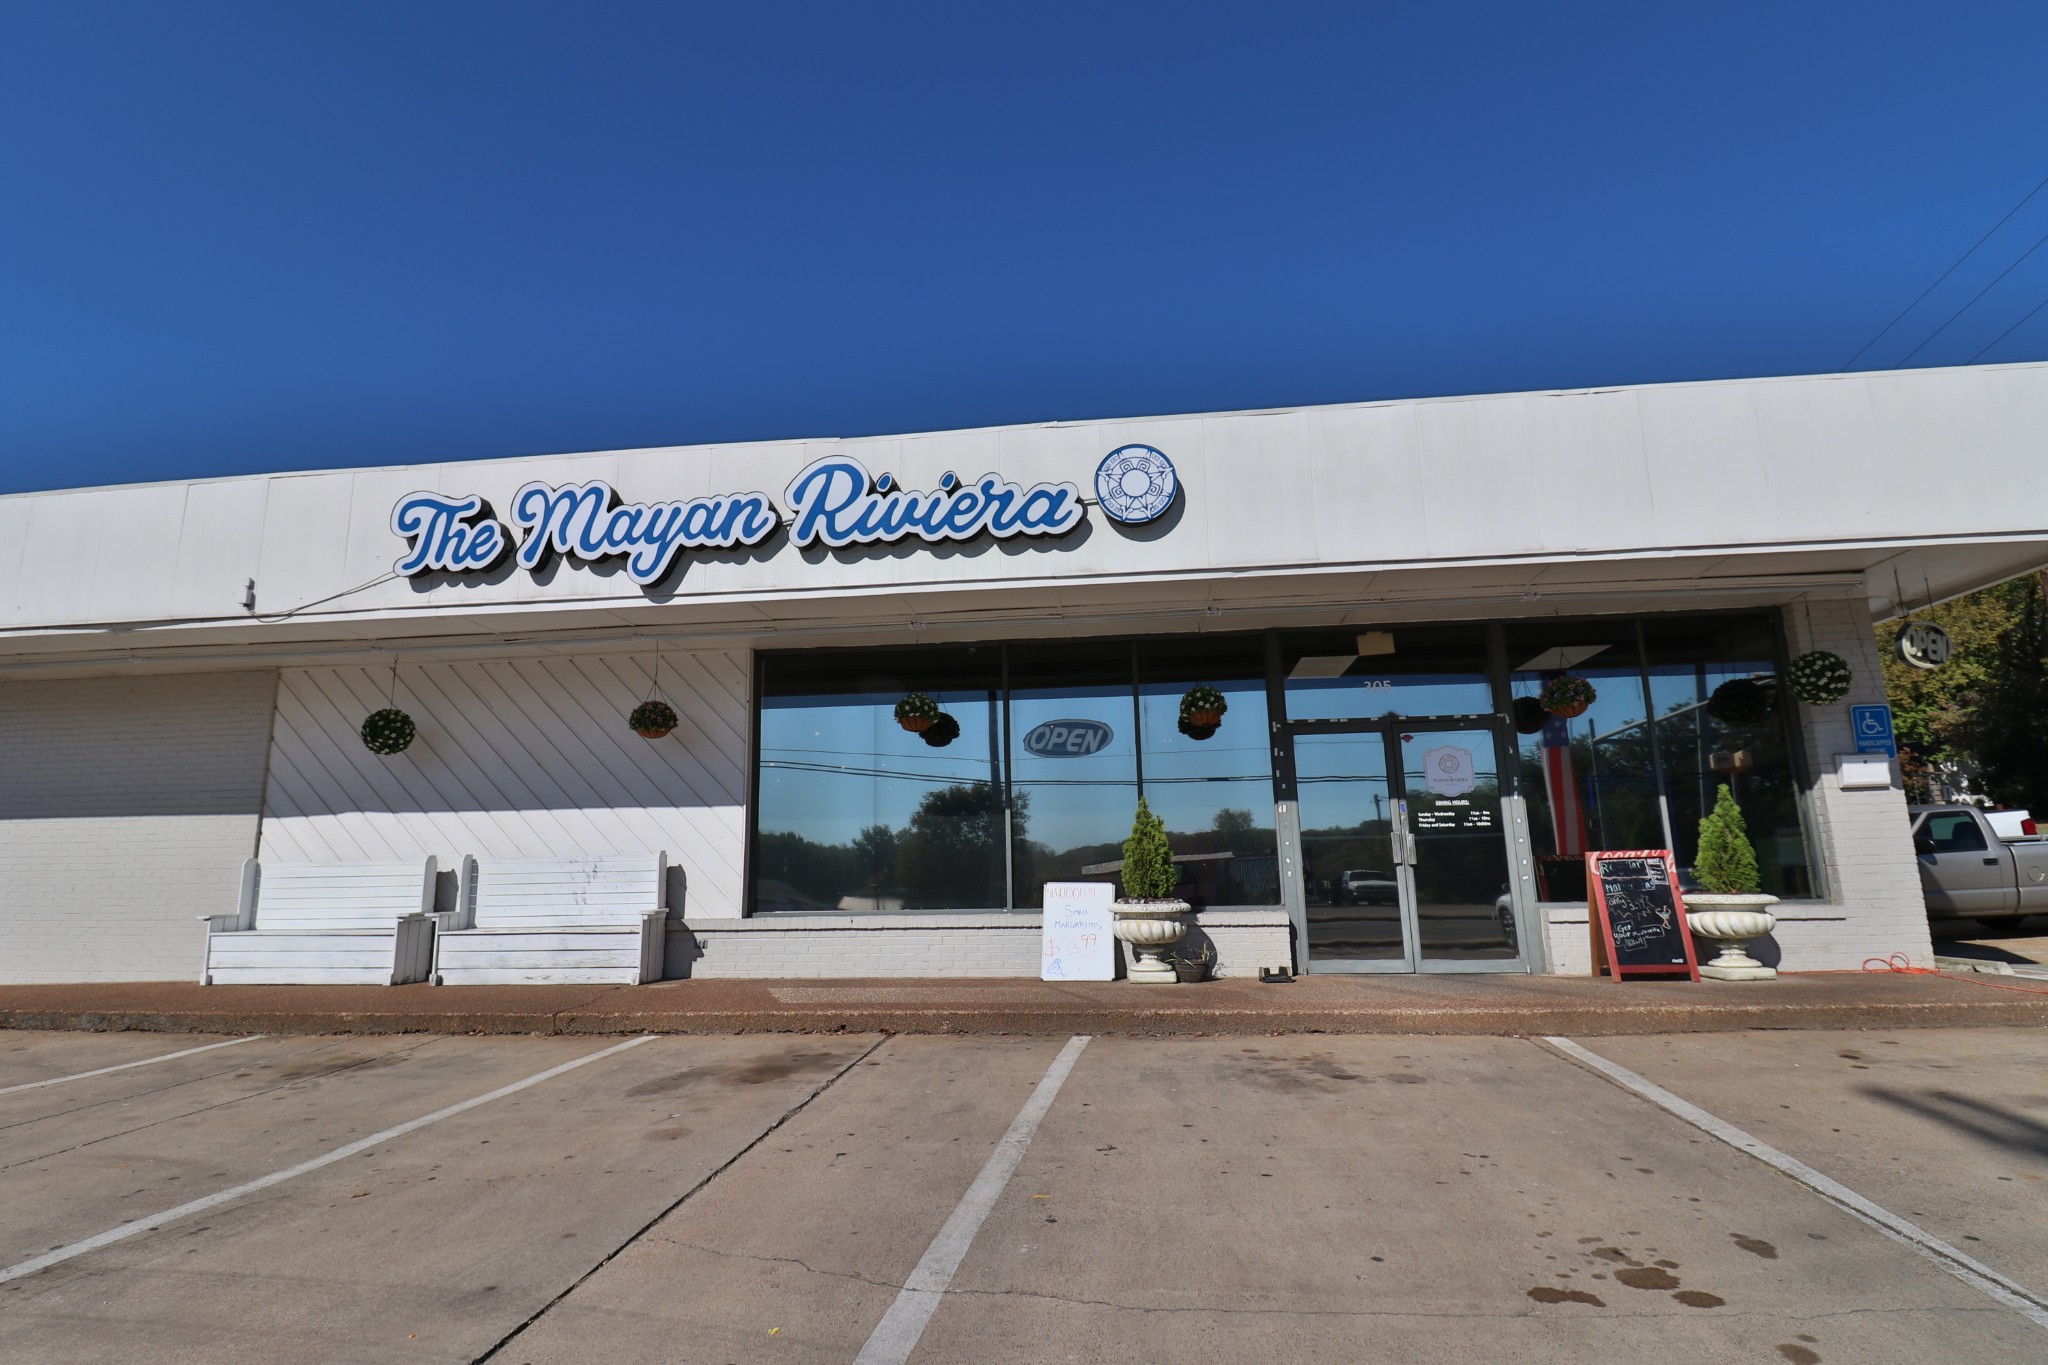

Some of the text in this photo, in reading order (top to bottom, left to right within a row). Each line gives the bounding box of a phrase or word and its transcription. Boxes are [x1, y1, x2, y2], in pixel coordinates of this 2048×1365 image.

[399, 463, 1074, 578] The Mayan Riviera
[1905, 627, 1947, 663] OPEN
[1029, 726, 1104, 753] OPEN
